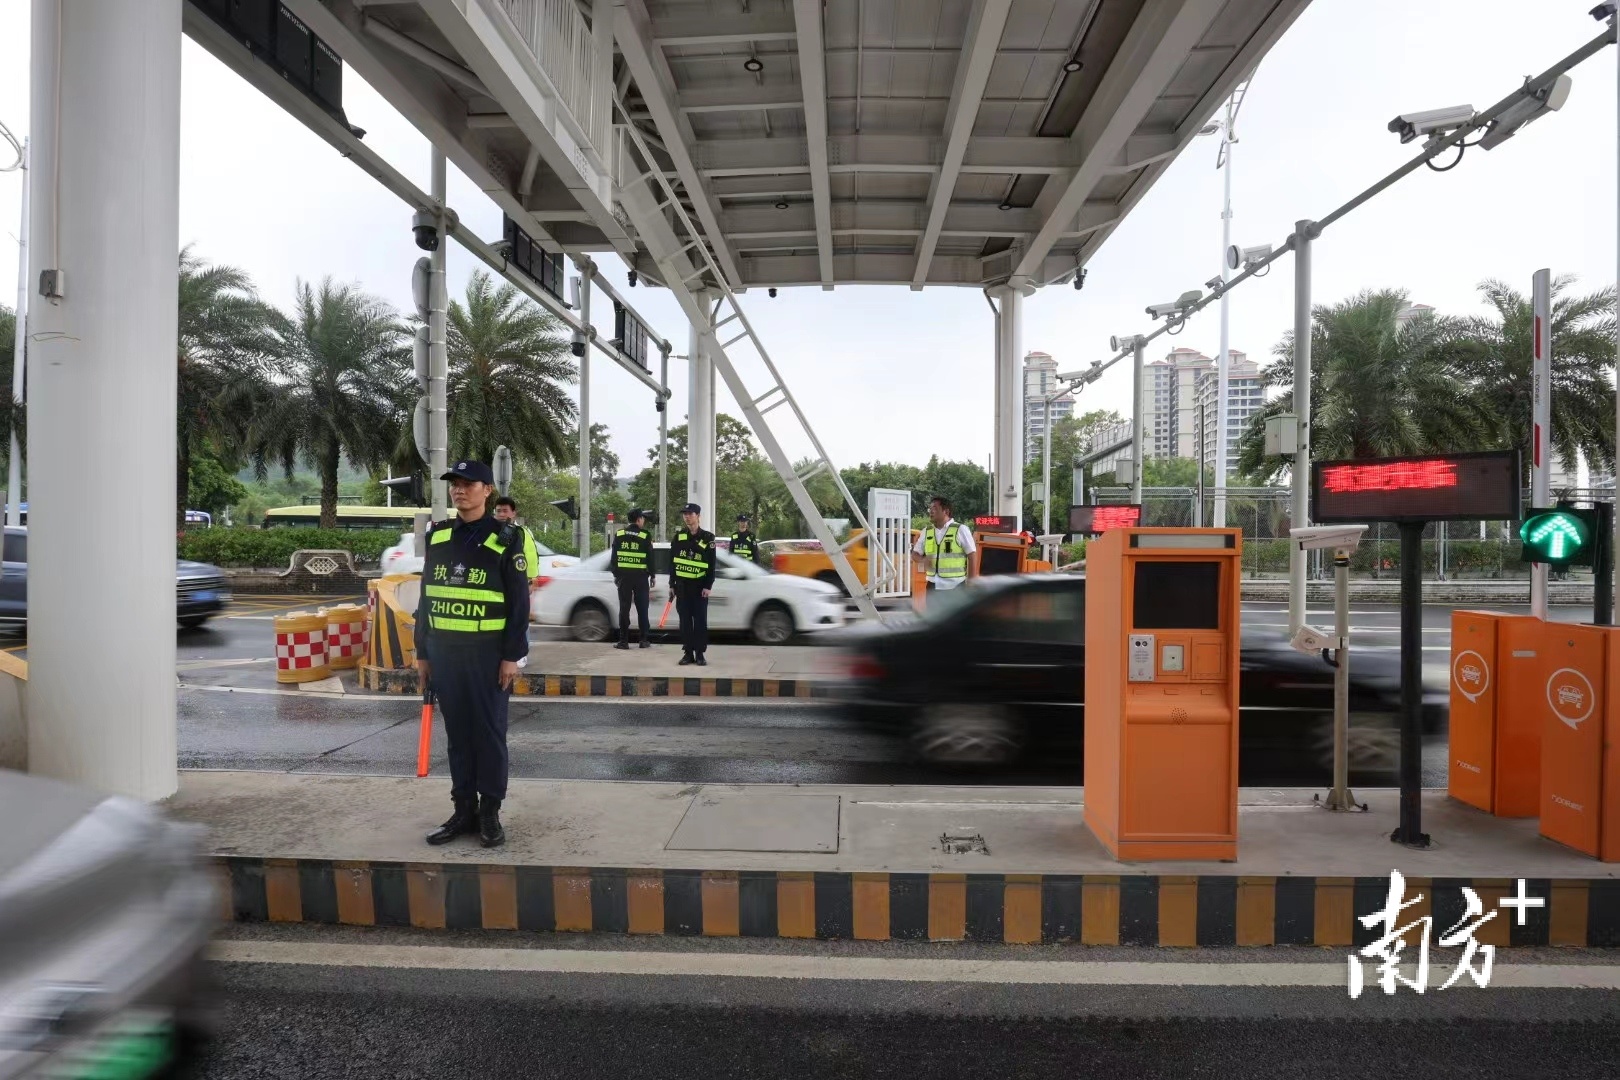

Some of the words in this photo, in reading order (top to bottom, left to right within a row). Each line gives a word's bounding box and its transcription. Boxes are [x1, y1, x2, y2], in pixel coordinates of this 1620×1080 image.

[434, 564, 487, 584] 执勤
[676, 564, 701, 573] ZHIQIN
[431, 600, 486, 617] ZHIQIN
